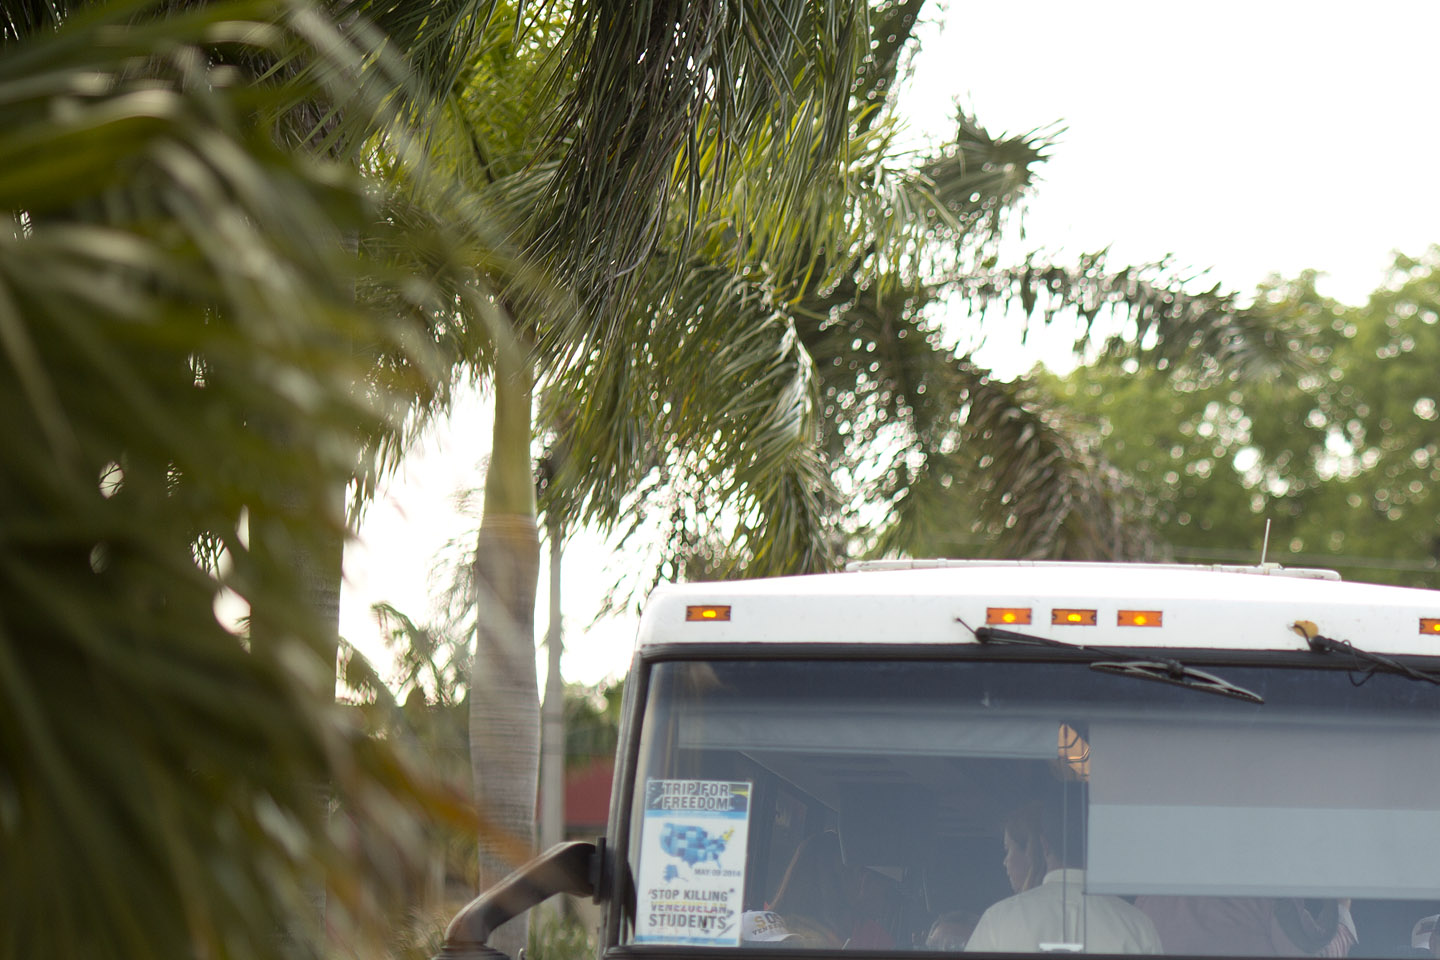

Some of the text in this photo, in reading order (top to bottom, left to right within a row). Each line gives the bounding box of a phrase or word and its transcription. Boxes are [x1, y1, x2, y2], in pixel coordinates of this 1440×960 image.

[663, 782, 730, 797] TRIP FOR
[662, 796, 730, 811] FREEDOM
[650, 901, 728, 915] VENEZUELAN
[648, 913, 728, 930] STUDENTS
